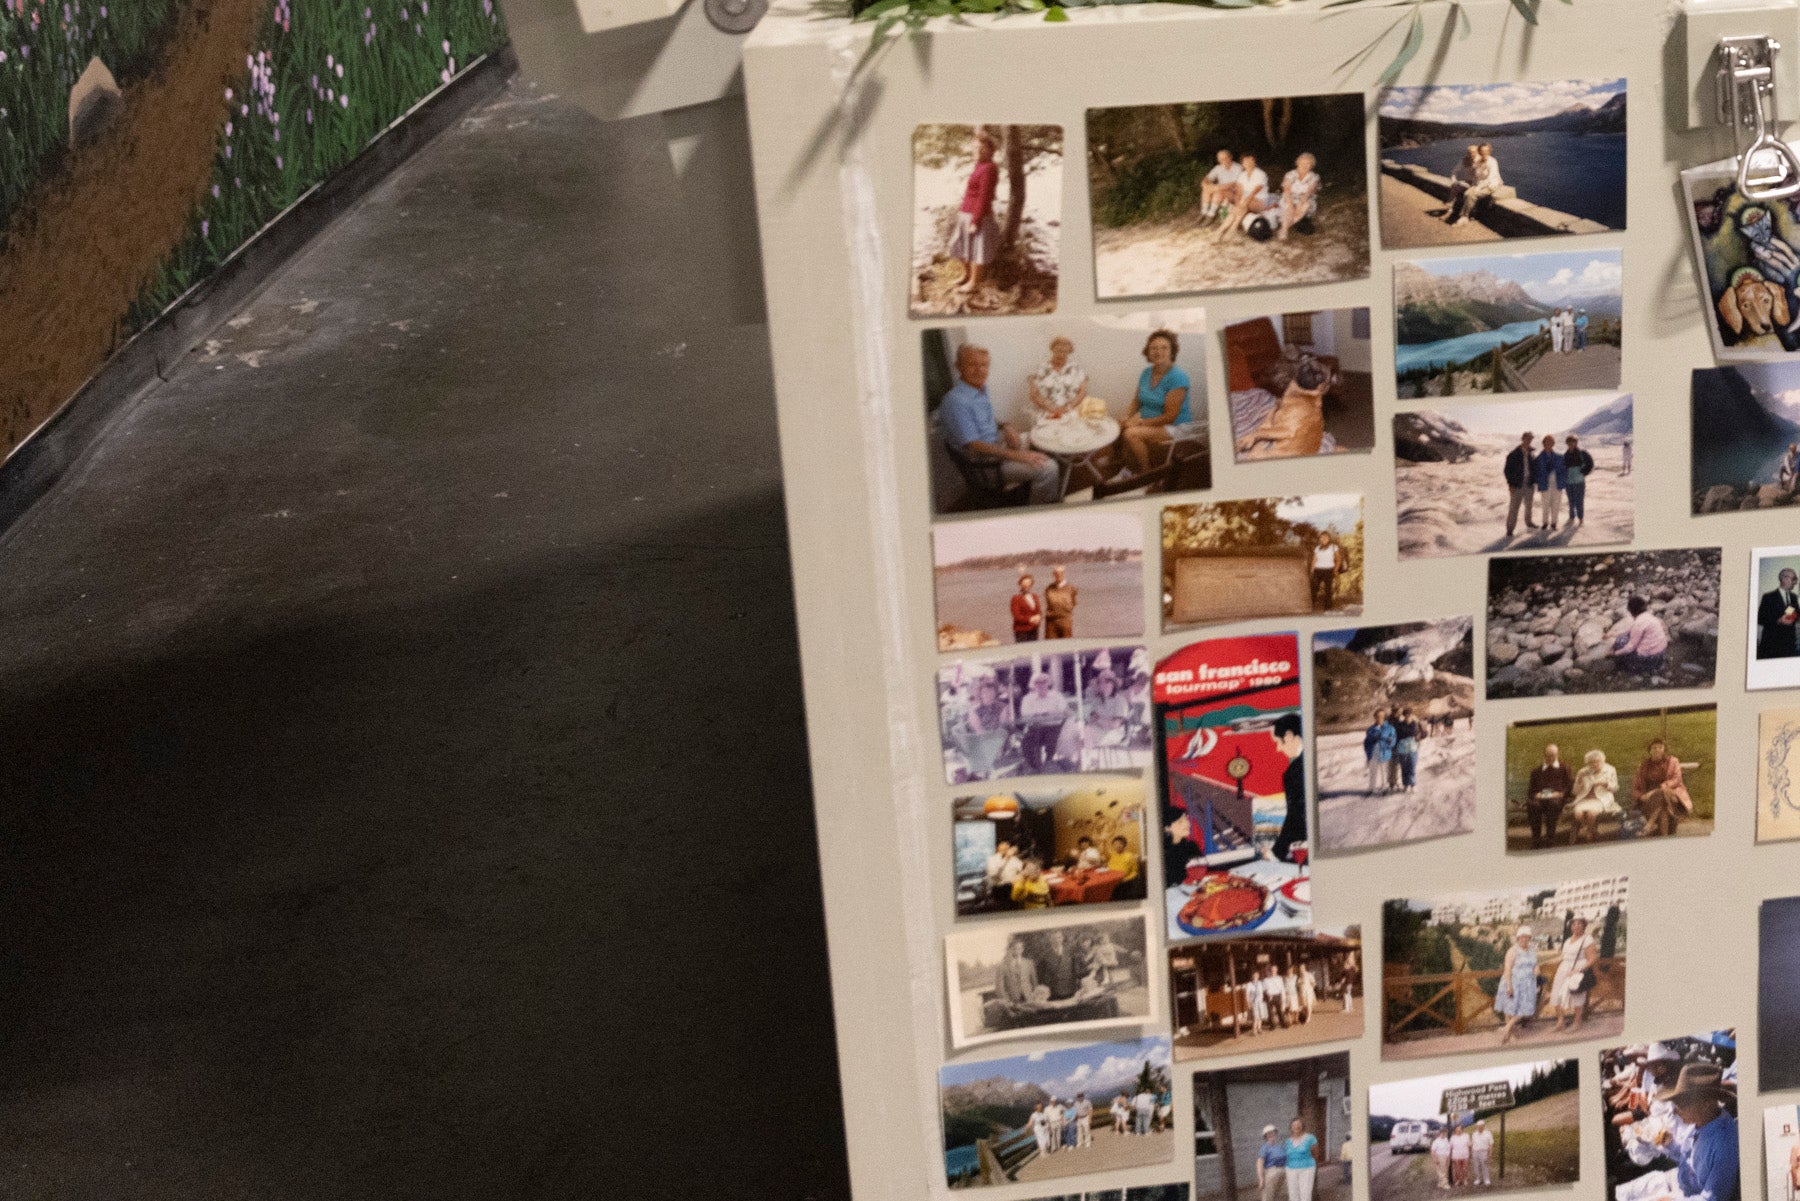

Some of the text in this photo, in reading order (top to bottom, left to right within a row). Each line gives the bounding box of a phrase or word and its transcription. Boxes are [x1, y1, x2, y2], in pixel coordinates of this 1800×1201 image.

[1155, 658, 1290, 685] san francisco
[1249, 675, 1282, 687] 1980
